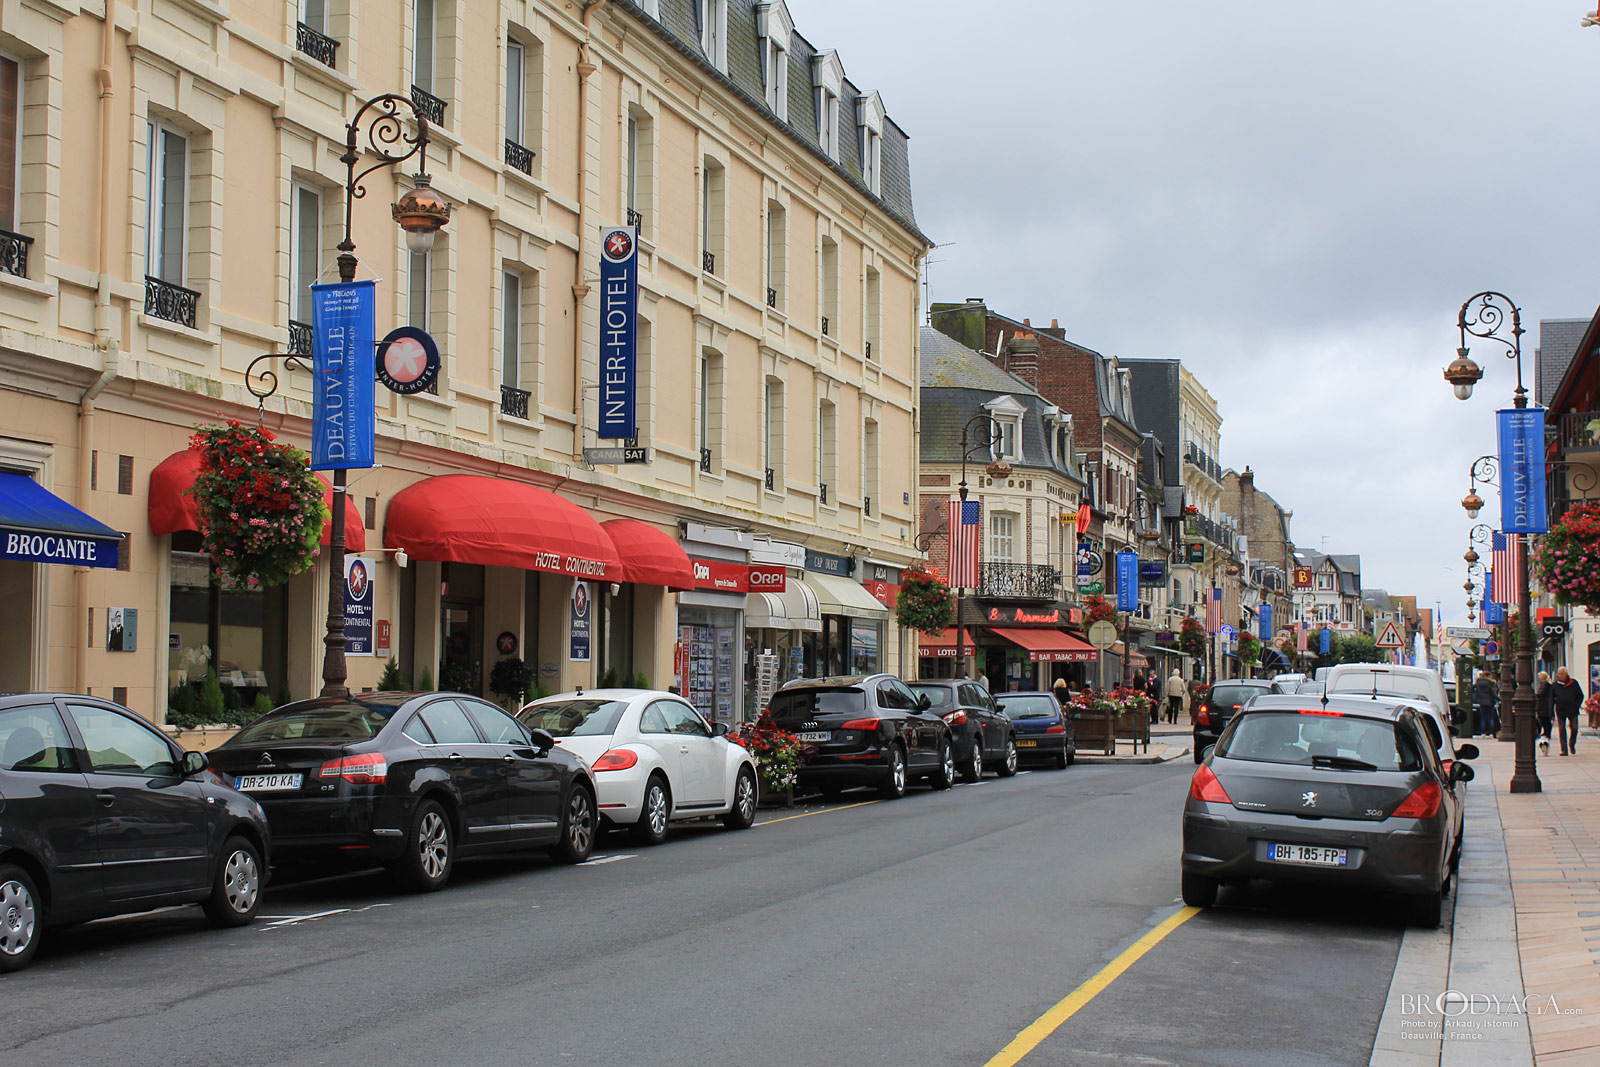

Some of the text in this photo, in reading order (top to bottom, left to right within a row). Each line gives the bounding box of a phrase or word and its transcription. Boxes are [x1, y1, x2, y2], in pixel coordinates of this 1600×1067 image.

[606, 268, 627, 424] INTER-HOTEL
[380, 364, 435, 392] INTER-HOTEL
[6, 534, 96, 560] BROCANTE
[536, 552, 606, 576] HOTEL CONTINENTAL
[814, 556, 823, 568] CAP
[694, 562, 710, 580] ORPI
[750, 572, 783, 584] ORPI
[875, 567, 887, 580] ADA
[1014, 608, 1059, 623] Normand
[383, 625, 389, 636] H
[1364, 808, 1383, 816] 308
